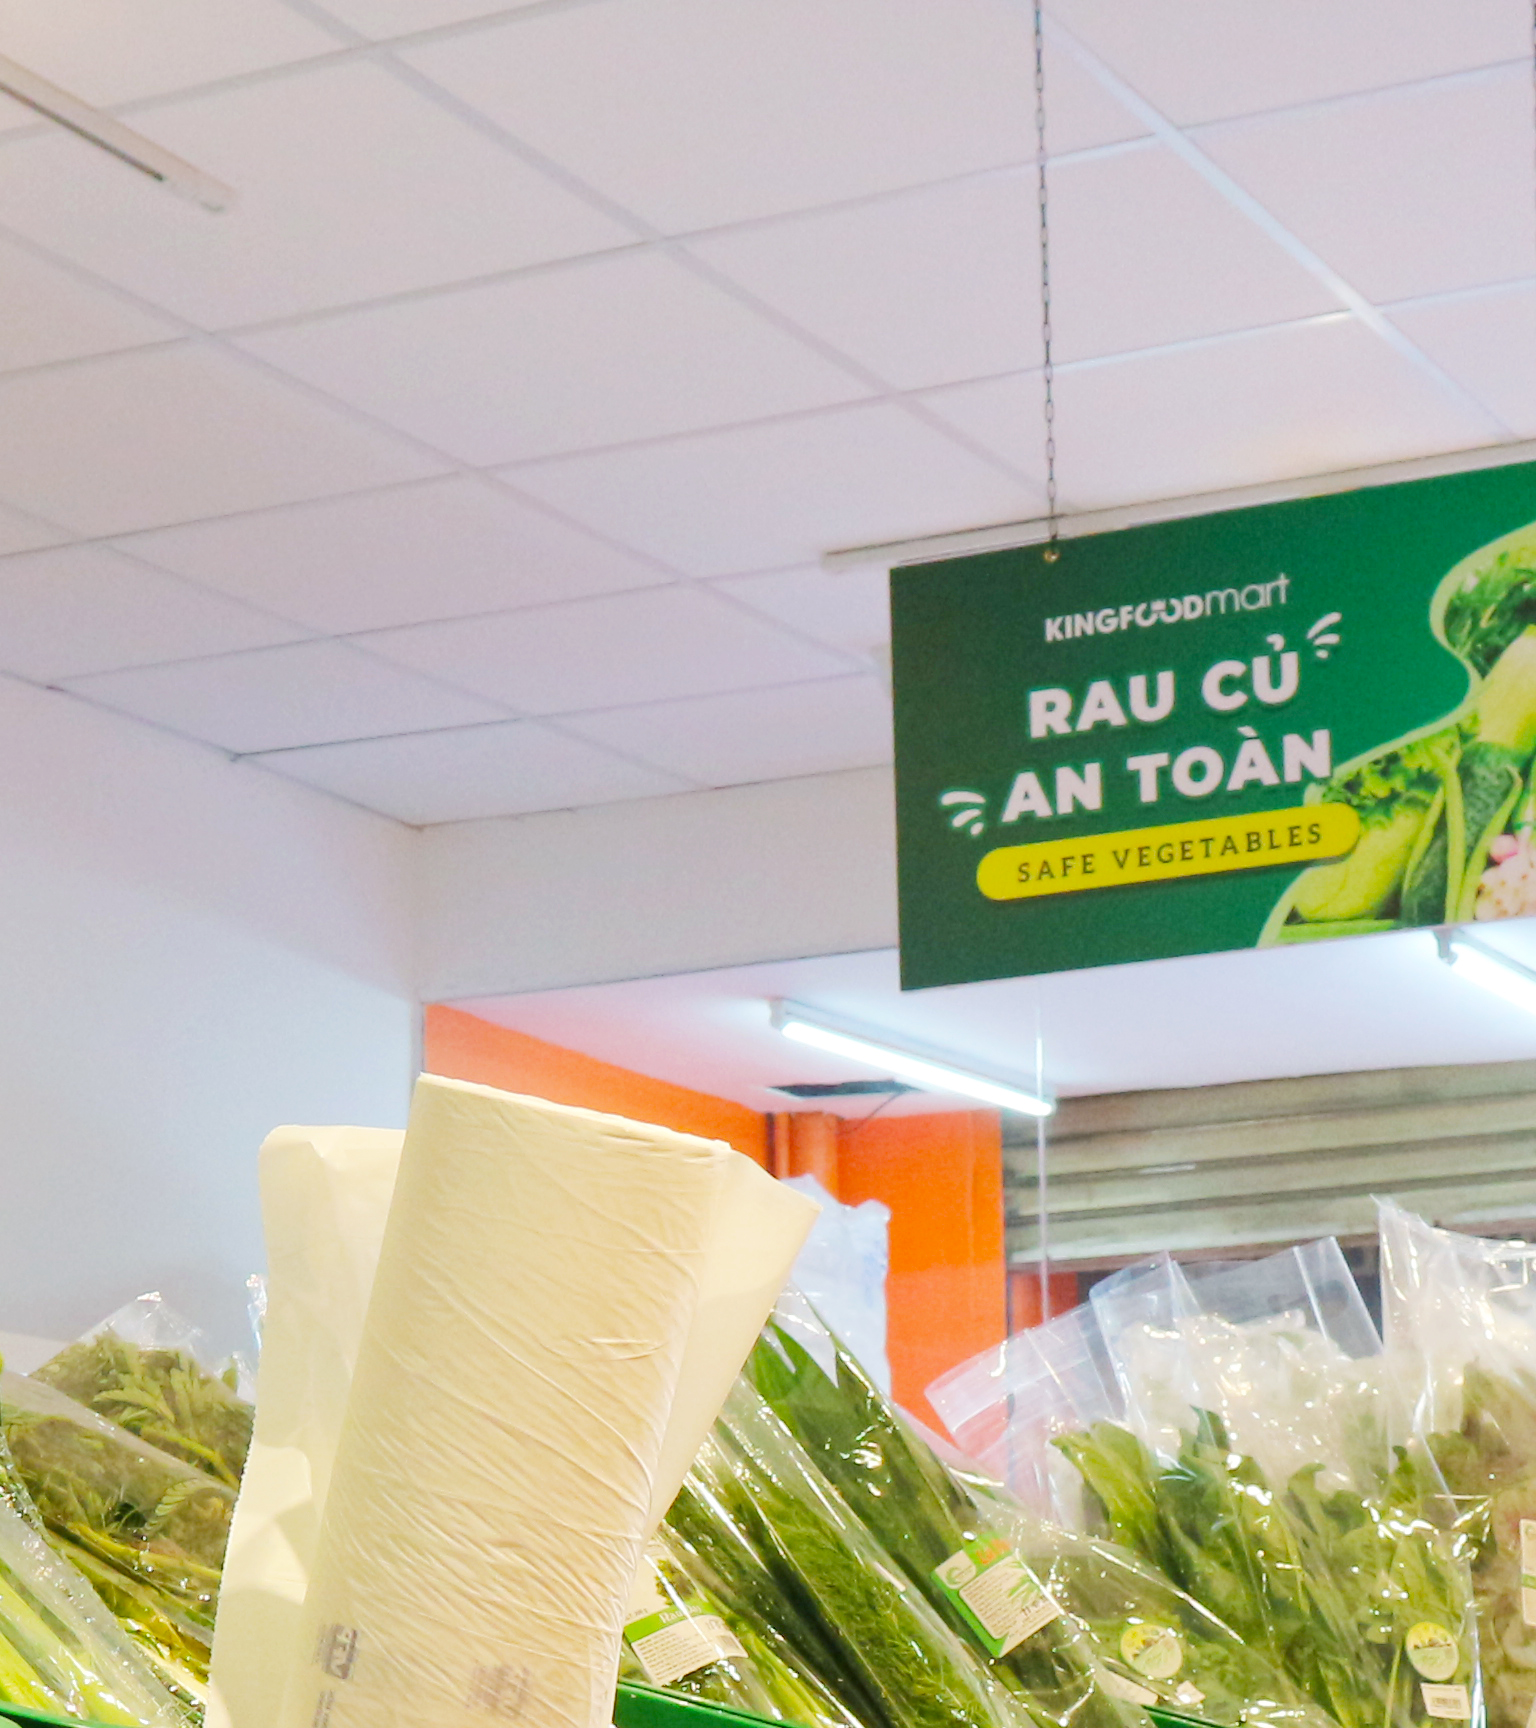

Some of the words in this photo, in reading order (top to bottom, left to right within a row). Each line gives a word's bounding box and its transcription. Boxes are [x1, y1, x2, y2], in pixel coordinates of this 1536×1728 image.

[1045, 573, 1290, 642] KINGFOODmart
[1028, 670, 1175, 739] RAU
[1201, 634, 1300, 711] CỦ
[1001, 762, 1103, 823] AN
[1126, 725, 1332, 803] TOÀN
[1017, 854, 1096, 883] SAFE
[1112, 823, 1322, 871] VEGETABLES
